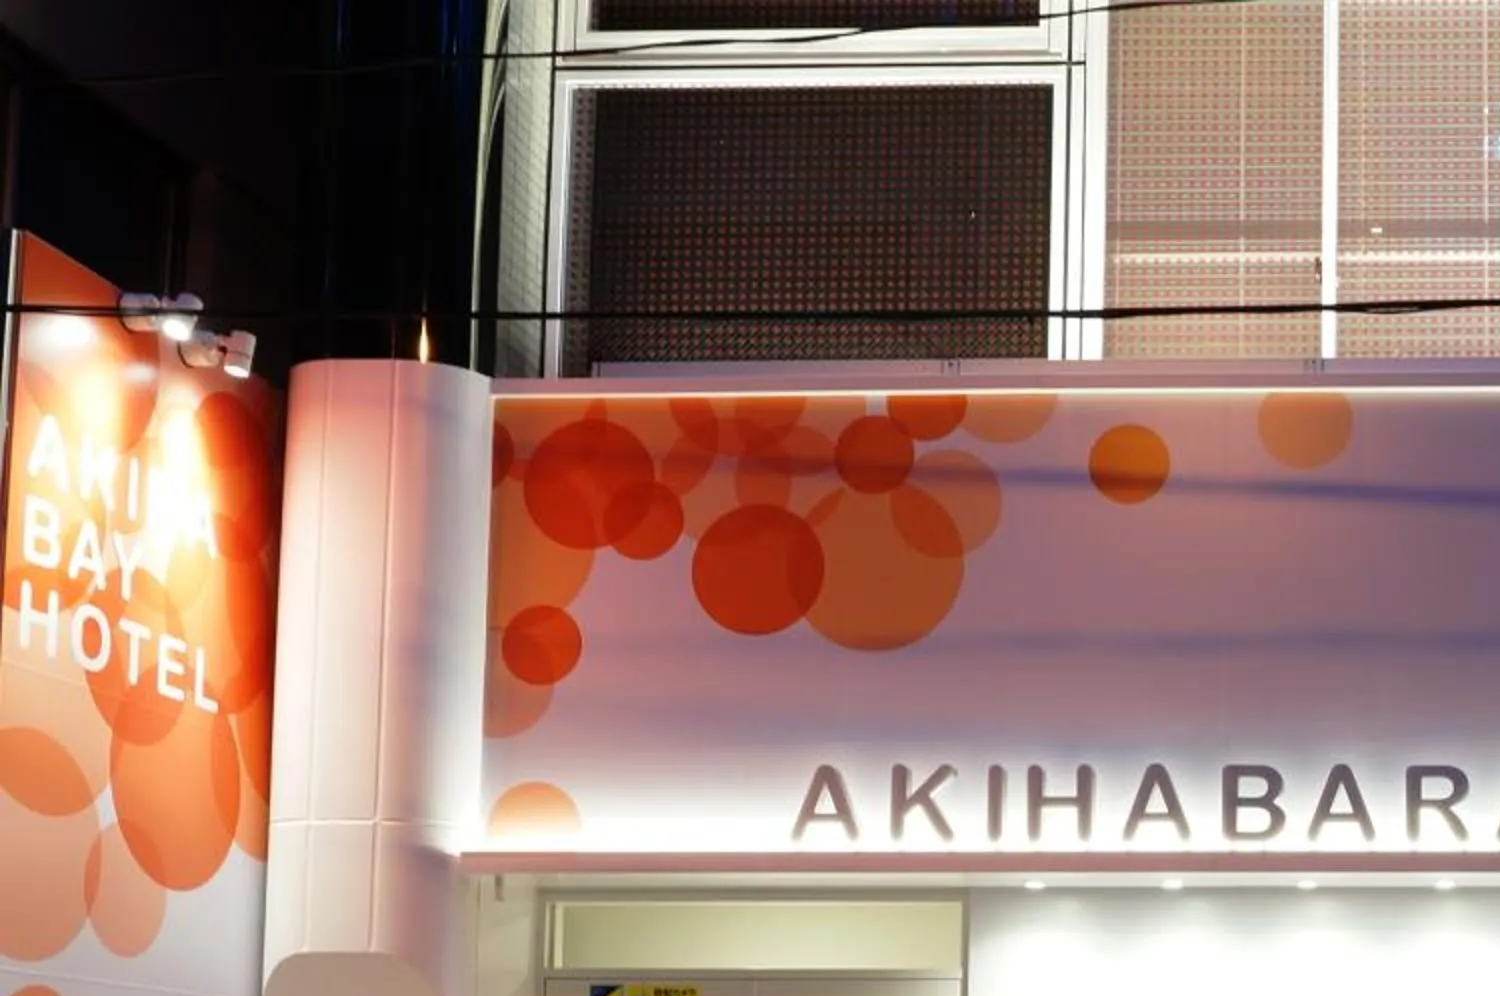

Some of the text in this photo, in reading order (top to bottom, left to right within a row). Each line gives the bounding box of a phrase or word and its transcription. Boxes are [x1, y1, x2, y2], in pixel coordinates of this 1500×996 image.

[22, 495, 148, 601] BAY
[27, 414, 219, 561] AKI
[19, 578, 219, 714] HOTEL
